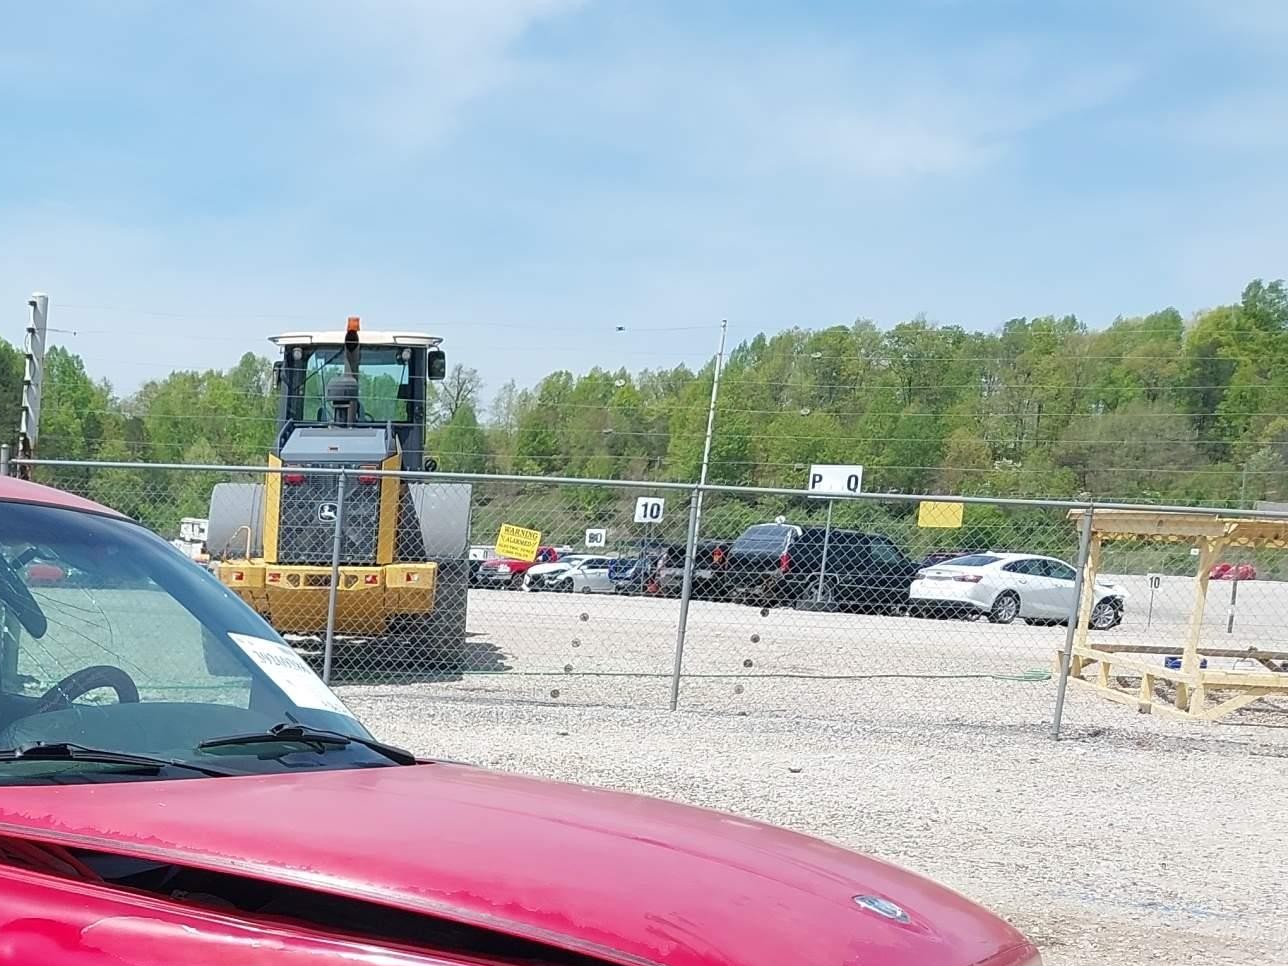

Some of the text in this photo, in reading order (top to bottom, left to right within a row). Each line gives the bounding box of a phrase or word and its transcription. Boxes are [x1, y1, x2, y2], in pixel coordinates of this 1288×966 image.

[811, 473, 859, 493] P Q
[641, 501, 661, 520] 10
[503, 525, 539, 540] WARNING
[1149, 575, 1161, 589] 10
